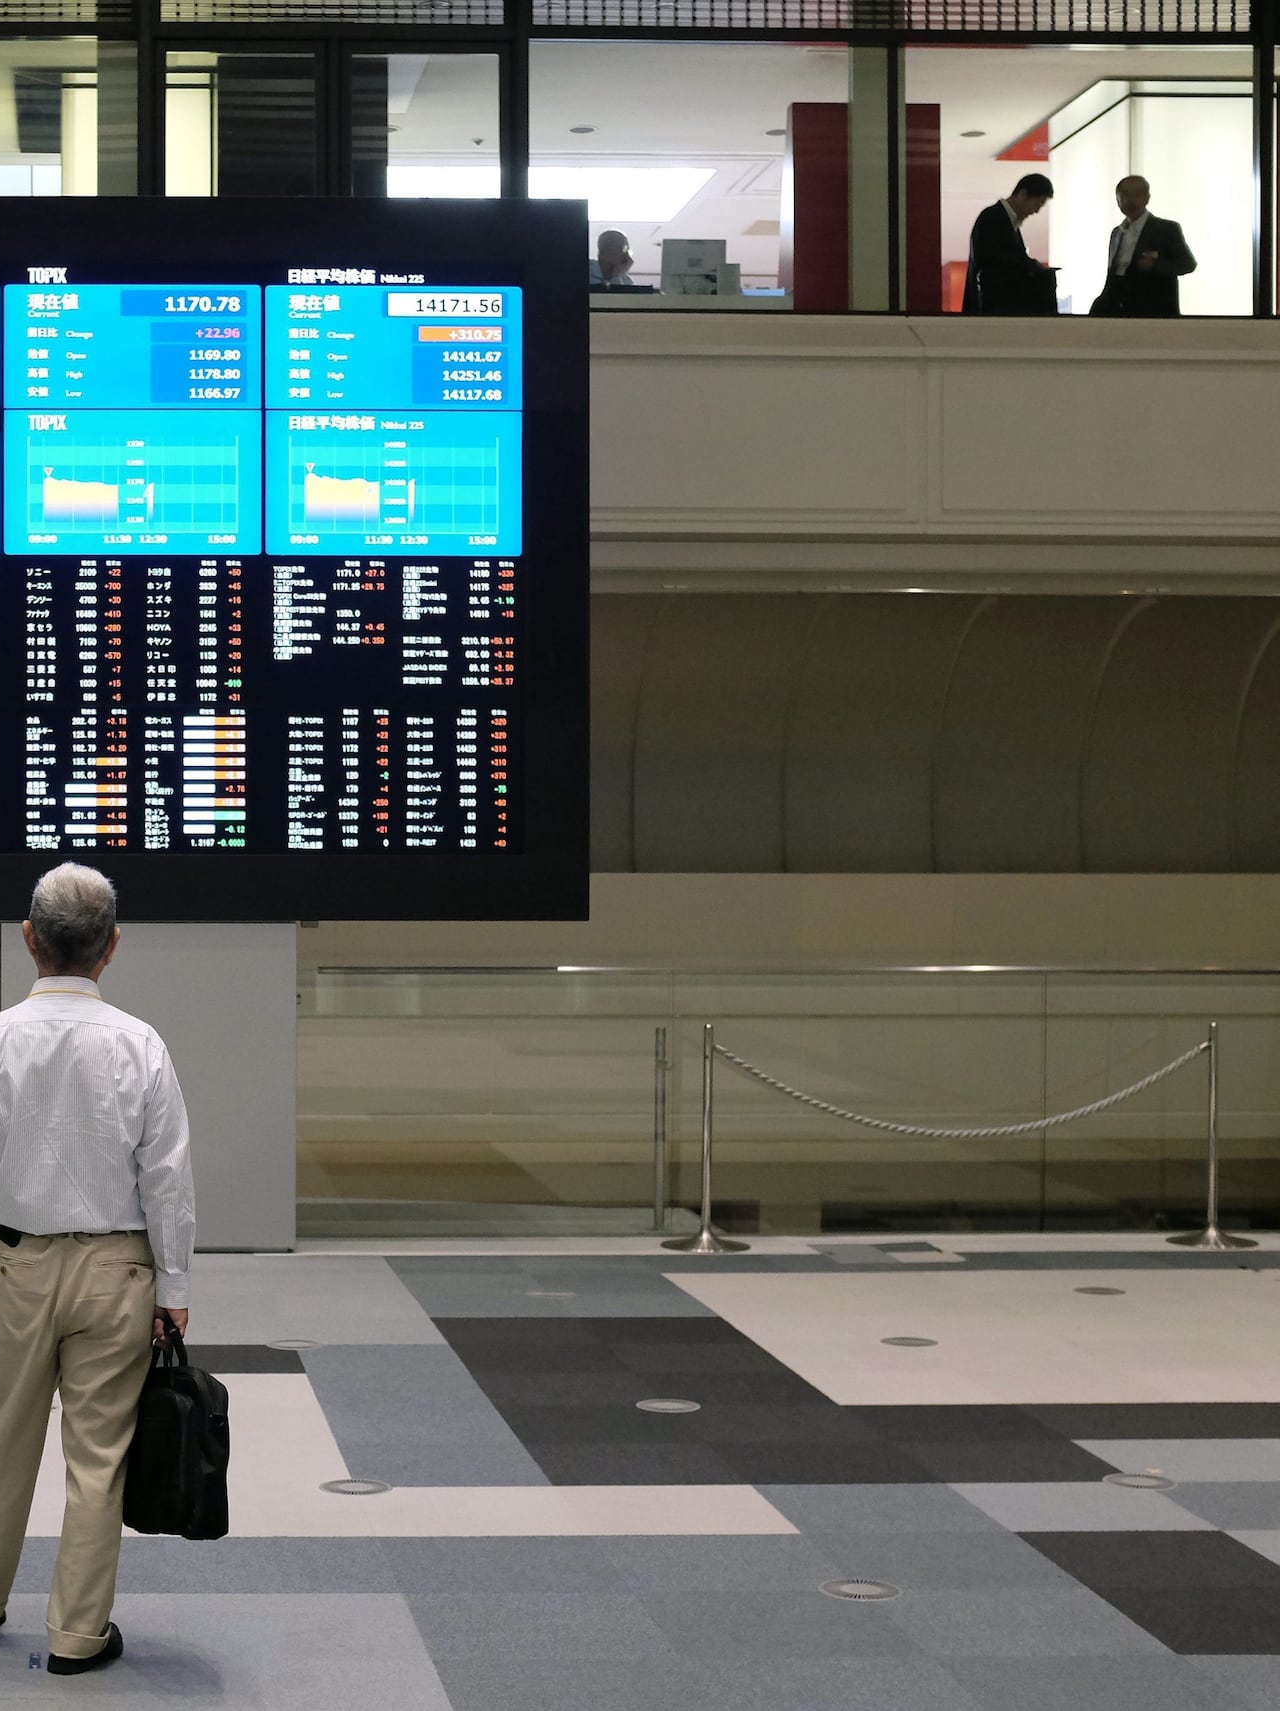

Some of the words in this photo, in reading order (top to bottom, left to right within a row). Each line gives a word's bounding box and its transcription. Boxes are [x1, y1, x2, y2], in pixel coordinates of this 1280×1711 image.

[27, 267, 67, 283] TOPIX
[408, 275, 424, 283] 225
[166, 297, 240, 312] 1170.78
[417, 300, 500, 312] 14171.56
[196, 328, 240, 338] +22.96
[449, 329, 501, 340] +310.75
[190, 350, 240, 360] 1169.80
[443, 352, 501, 362] 14141.67
[190, 369, 240, 379] 1178.80
[443, 371, 501, 381] 14251.46
[190, 388, 240, 398] 1166.97
[443, 390, 501, 400] 14117.68
[28, 415, 66, 430] TOPIX
[27, 568, 51, 576] ソニー
